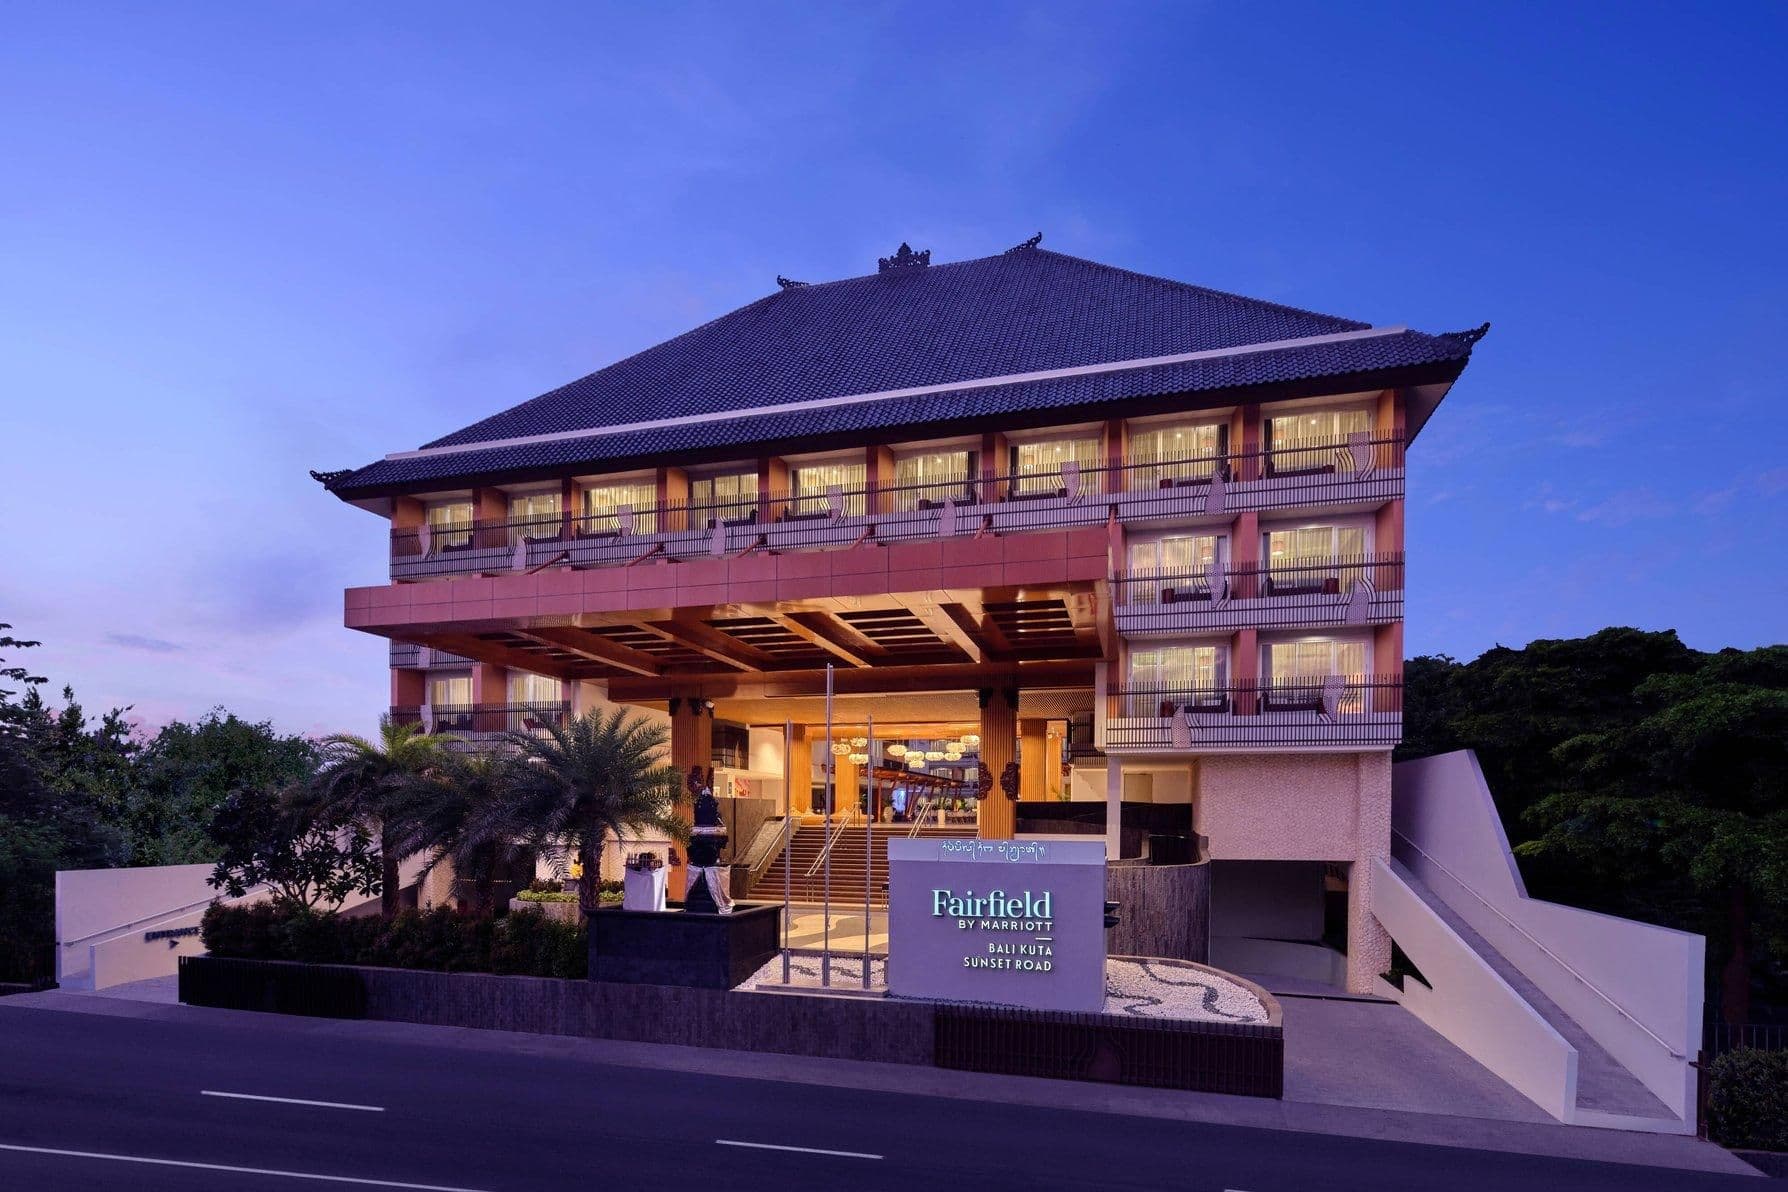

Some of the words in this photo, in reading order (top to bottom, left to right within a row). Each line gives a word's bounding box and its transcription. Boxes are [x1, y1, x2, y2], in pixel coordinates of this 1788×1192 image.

[932, 889, 1053, 919] Fairfield
[958, 920, 975, 929] BY
[981, 921, 1053, 931] MARRIOTT
[989, 943, 1016, 954] BALI
[1020, 944, 1052, 956] KUTA
[963, 957, 1011, 969] SUNSET
[1015, 960, 1052, 971] ROAD
